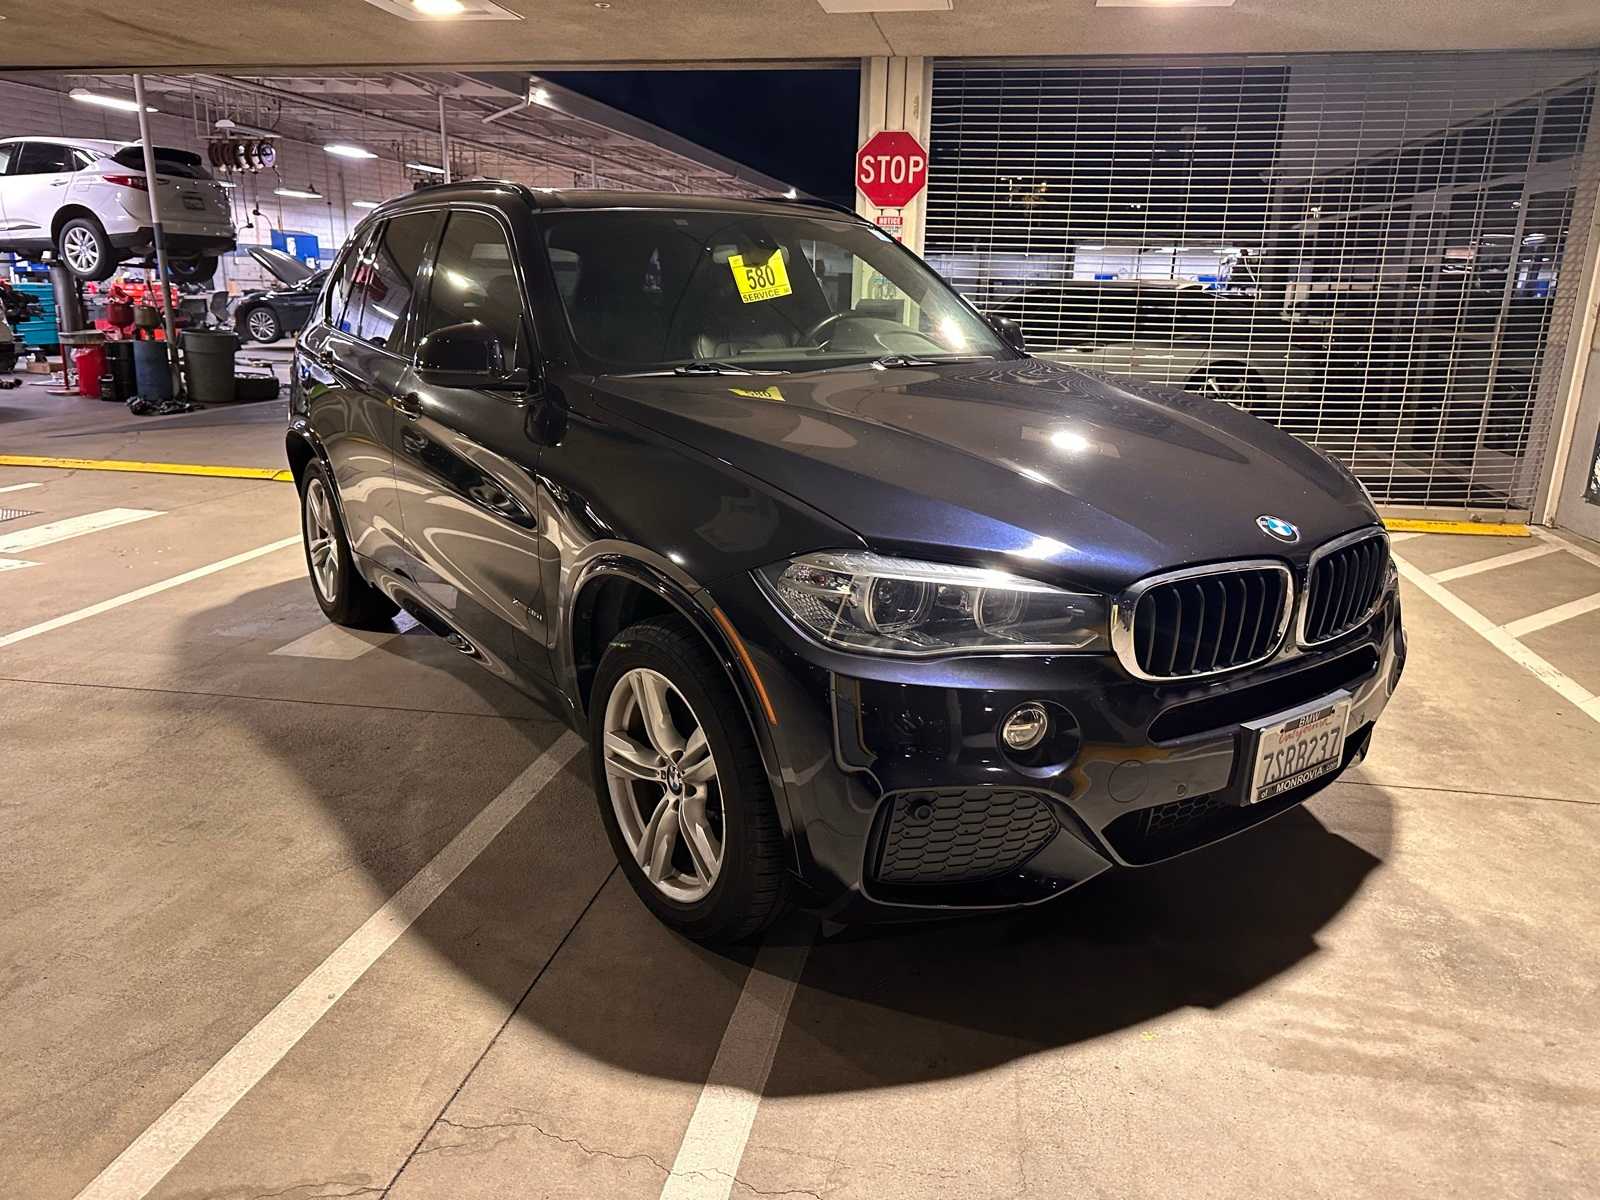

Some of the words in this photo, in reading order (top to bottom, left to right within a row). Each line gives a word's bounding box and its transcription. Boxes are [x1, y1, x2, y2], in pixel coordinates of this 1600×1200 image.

[860, 155, 925, 185] STOP
[745, 264, 776, 290] 580
[742, 288, 780, 302] SERVICE
[1299, 712, 1321, 728] BMW
[1276, 767, 1324, 793] MONROVIA
